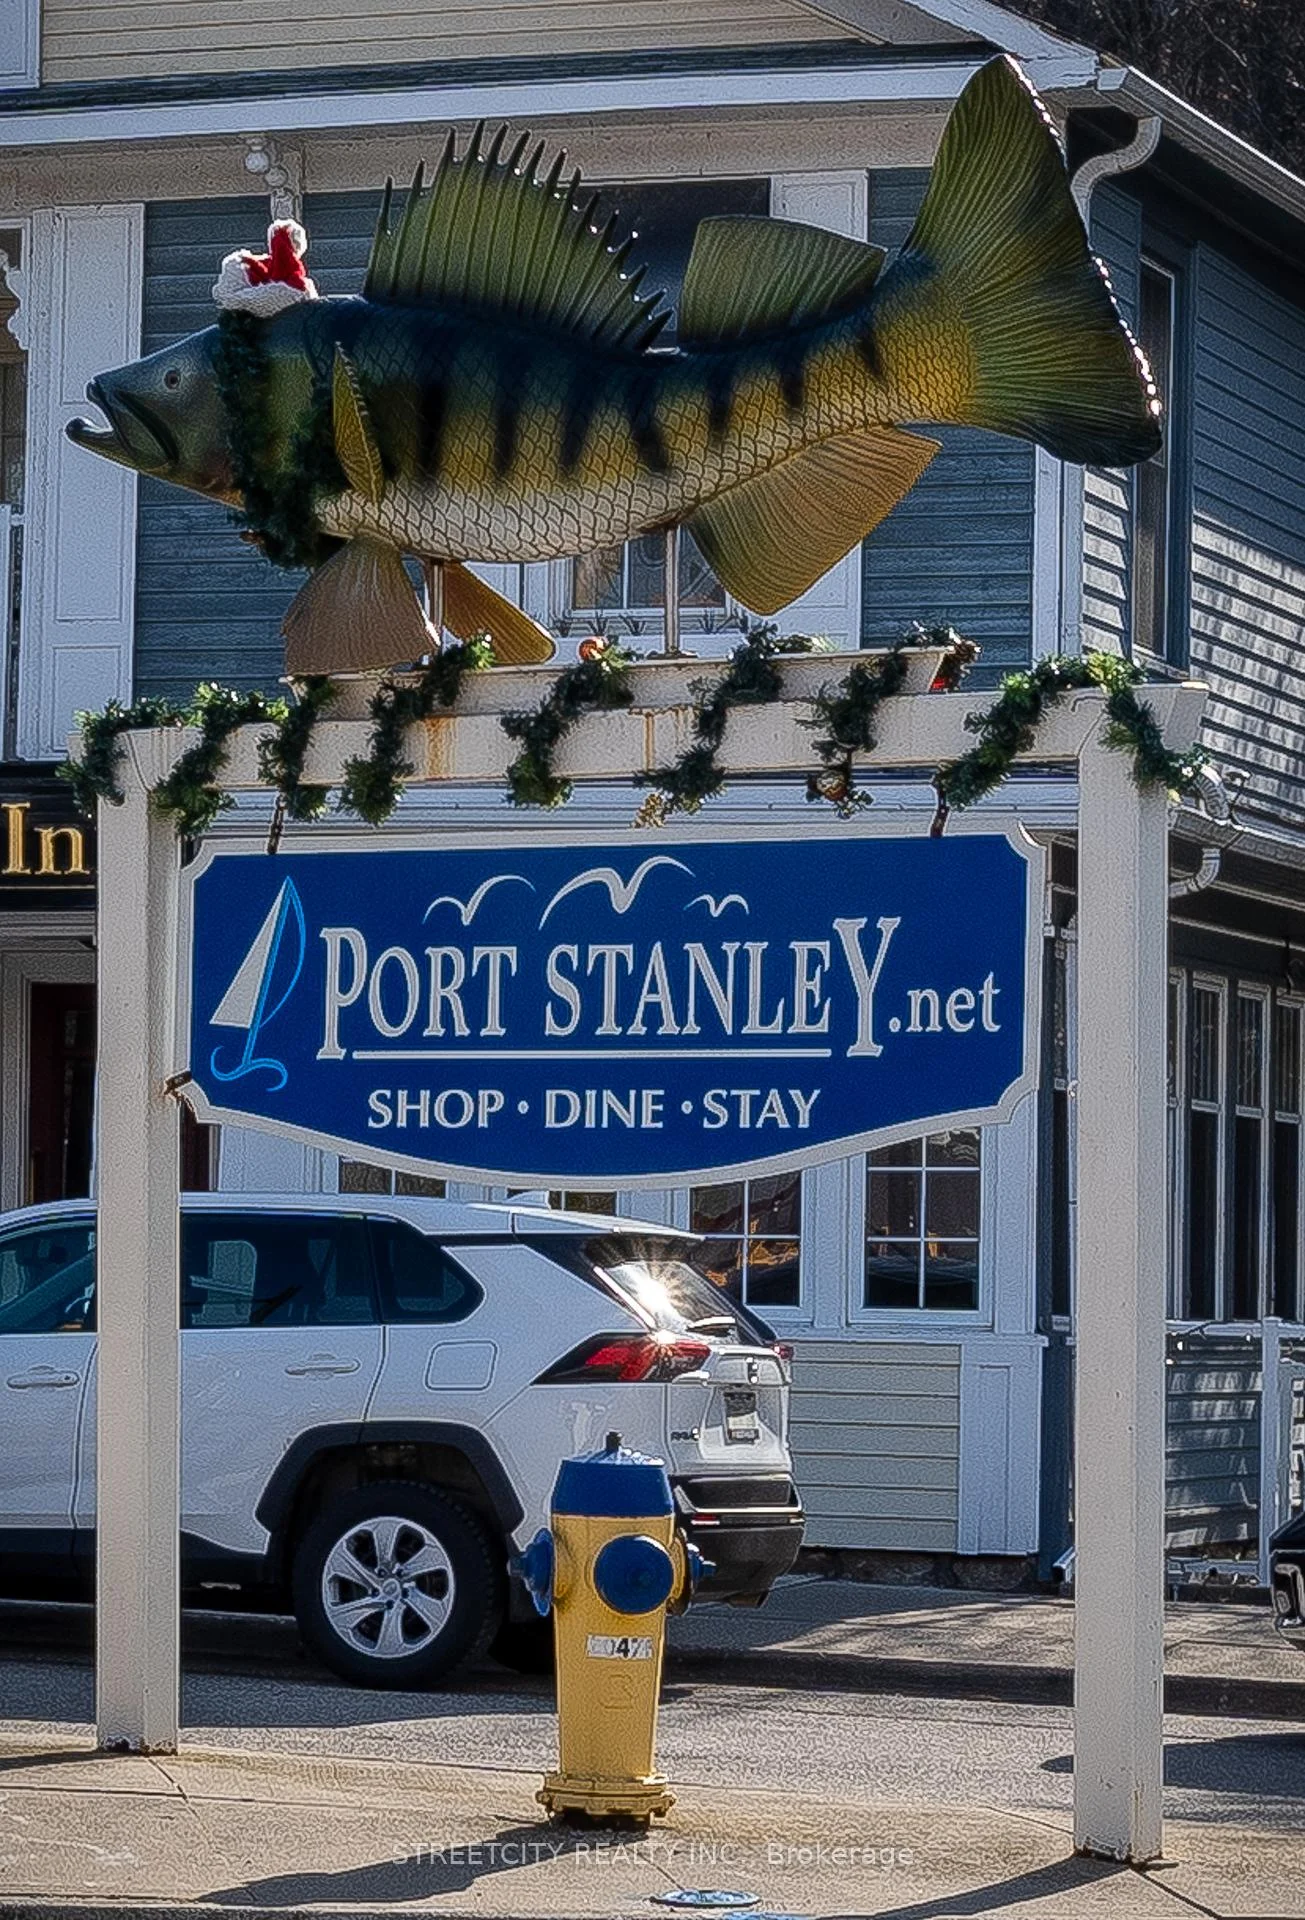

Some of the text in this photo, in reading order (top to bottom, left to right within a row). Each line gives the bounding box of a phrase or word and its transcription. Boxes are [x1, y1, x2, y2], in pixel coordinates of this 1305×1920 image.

[316, 927, 517, 1060] PORT
[367, 1089, 821, 1129] SHOP DINE STAY
